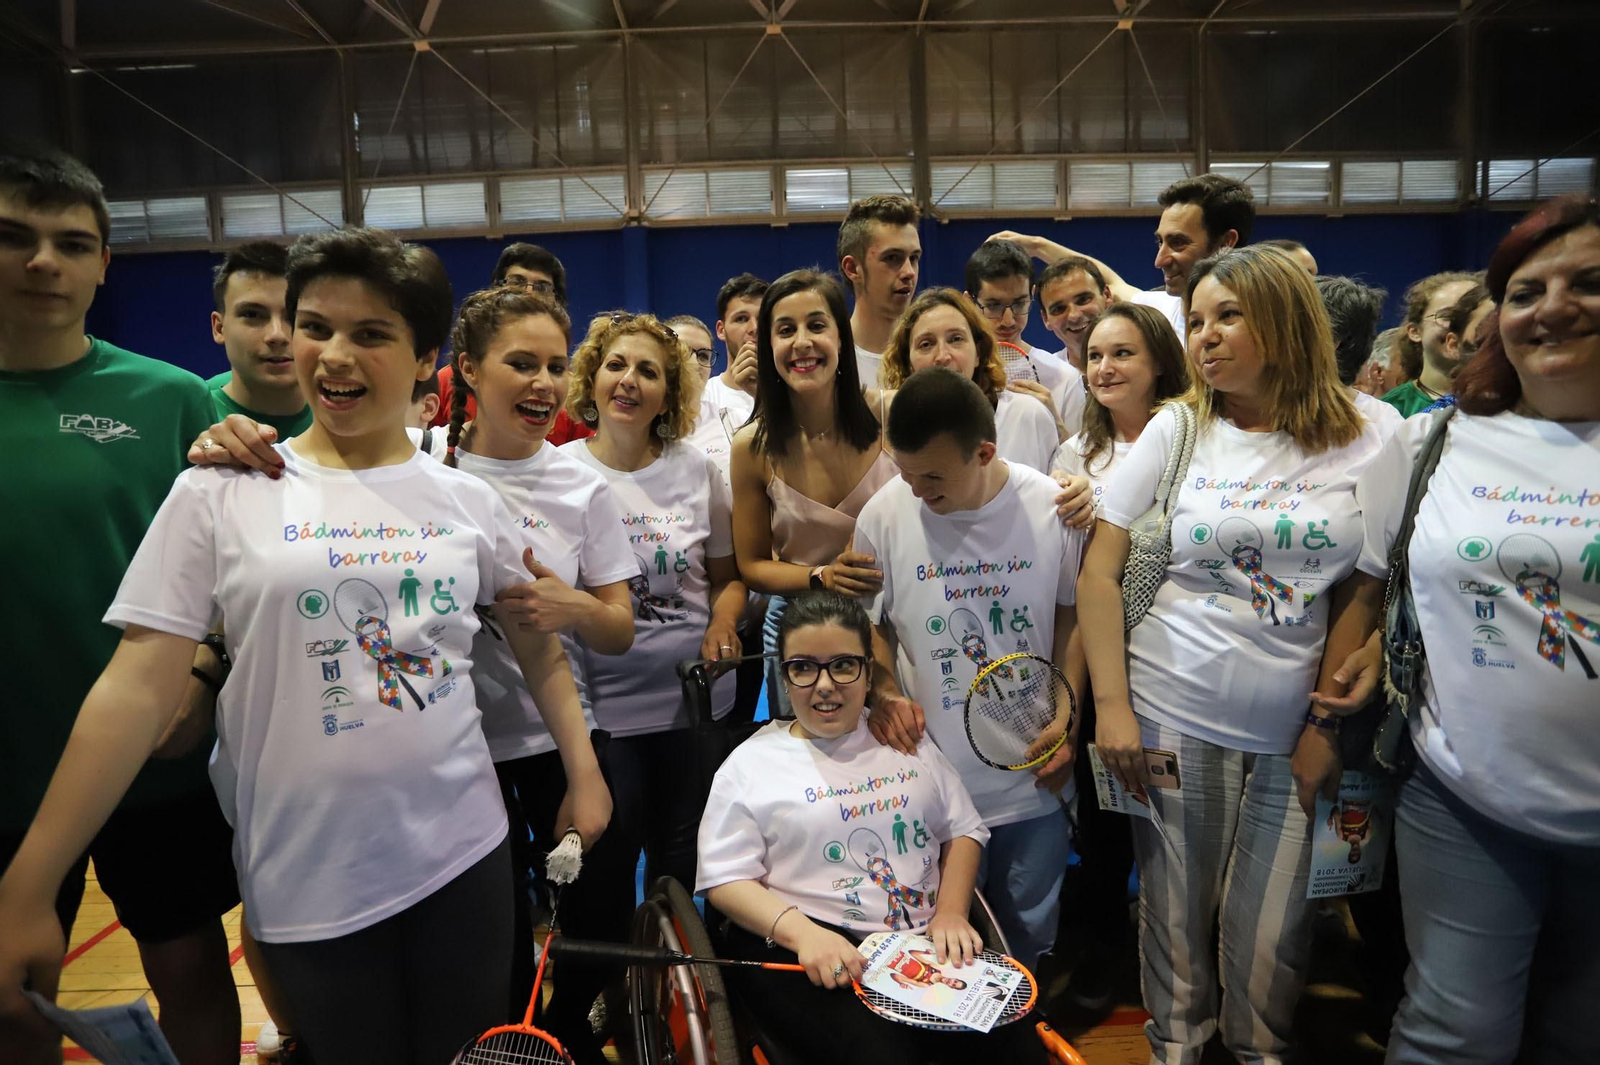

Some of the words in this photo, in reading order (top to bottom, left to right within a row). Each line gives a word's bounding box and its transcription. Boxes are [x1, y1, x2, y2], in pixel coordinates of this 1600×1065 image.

[706, 445, 723, 455] sin
[1195, 476, 1291, 492] Bádminton
[1296, 480, 1328, 493] sin
[1220, 494, 1300, 512] barreras
[1471, 485, 1600, 508] Bádminto
[522, 513, 549, 529] sin
[666, 512, 686, 525] sin
[1506, 508, 1600, 529] barrer
[284, 521, 415, 543] Bádminton
[420, 521, 454, 540] sin
[628, 531, 671, 545] rreras
[328, 546, 427, 569] barreras
[916, 559, 1004, 581] Bádminton
[1007, 555, 1032, 574] sin
[944, 584, 1011, 602] barreras
[805, 775, 895, 804] Bádminton
[897, 767, 918, 783] sin
[839, 794, 909, 822] barreras
[1316, 868, 1335, 876] 2018
[1312, 886, 1346, 896] EUROPEAN
[964, 978, 985, 1002] HUELVA
[953, 1001, 969, 1018] 2018
[980, 1000, 1002, 1028] EUROPEAN
